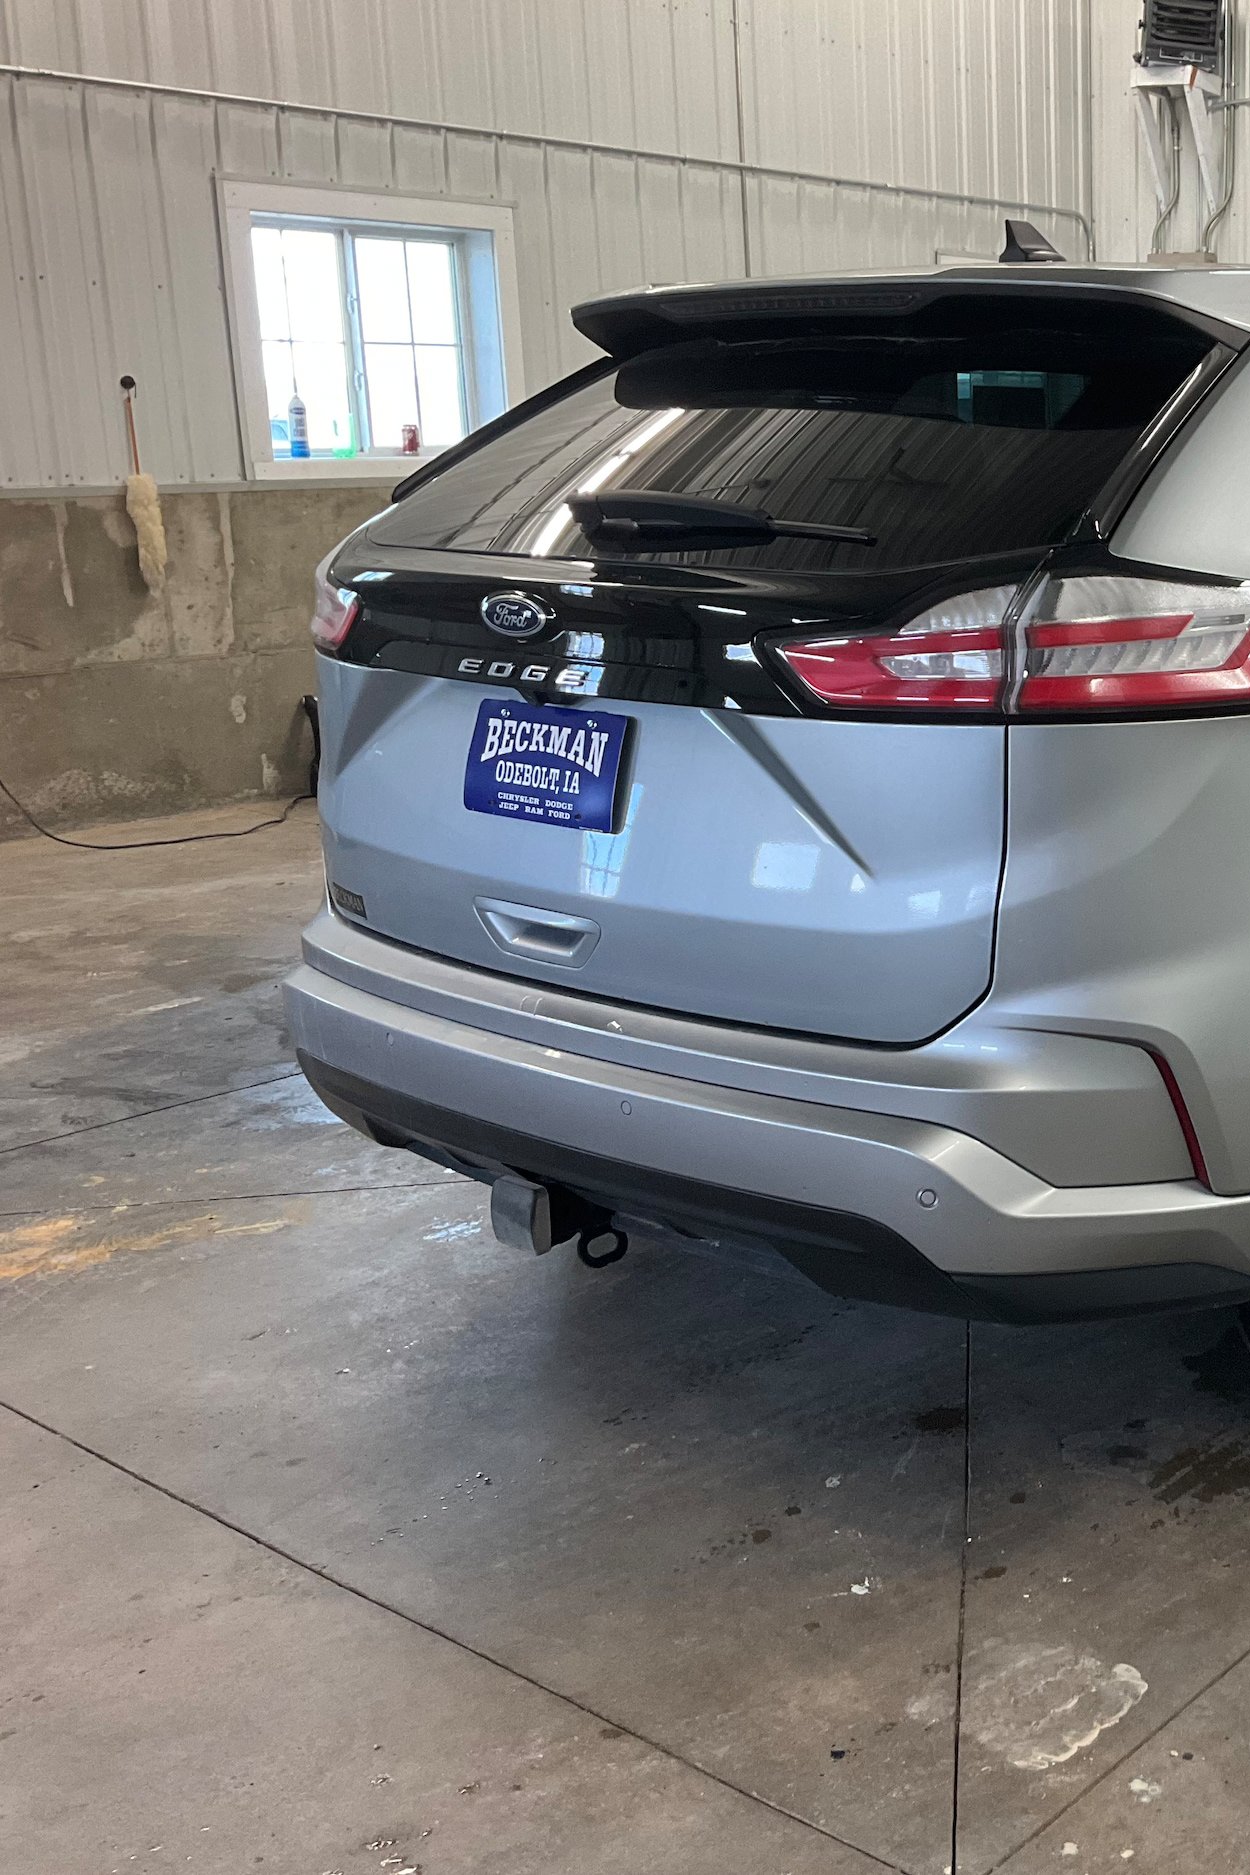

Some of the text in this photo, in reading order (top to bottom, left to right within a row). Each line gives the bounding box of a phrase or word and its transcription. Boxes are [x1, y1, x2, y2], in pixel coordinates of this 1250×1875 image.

[493, 602, 530, 628] Ford
[457, 658, 587, 687] EDGE
[480, 717, 609, 777] BECKMAN
[495, 760, 580, 795] ODEBOLT, IA
[497, 791, 573, 811] CHRYSLER DODGE
[499, 801, 571, 820] JEEP RAM FORD
